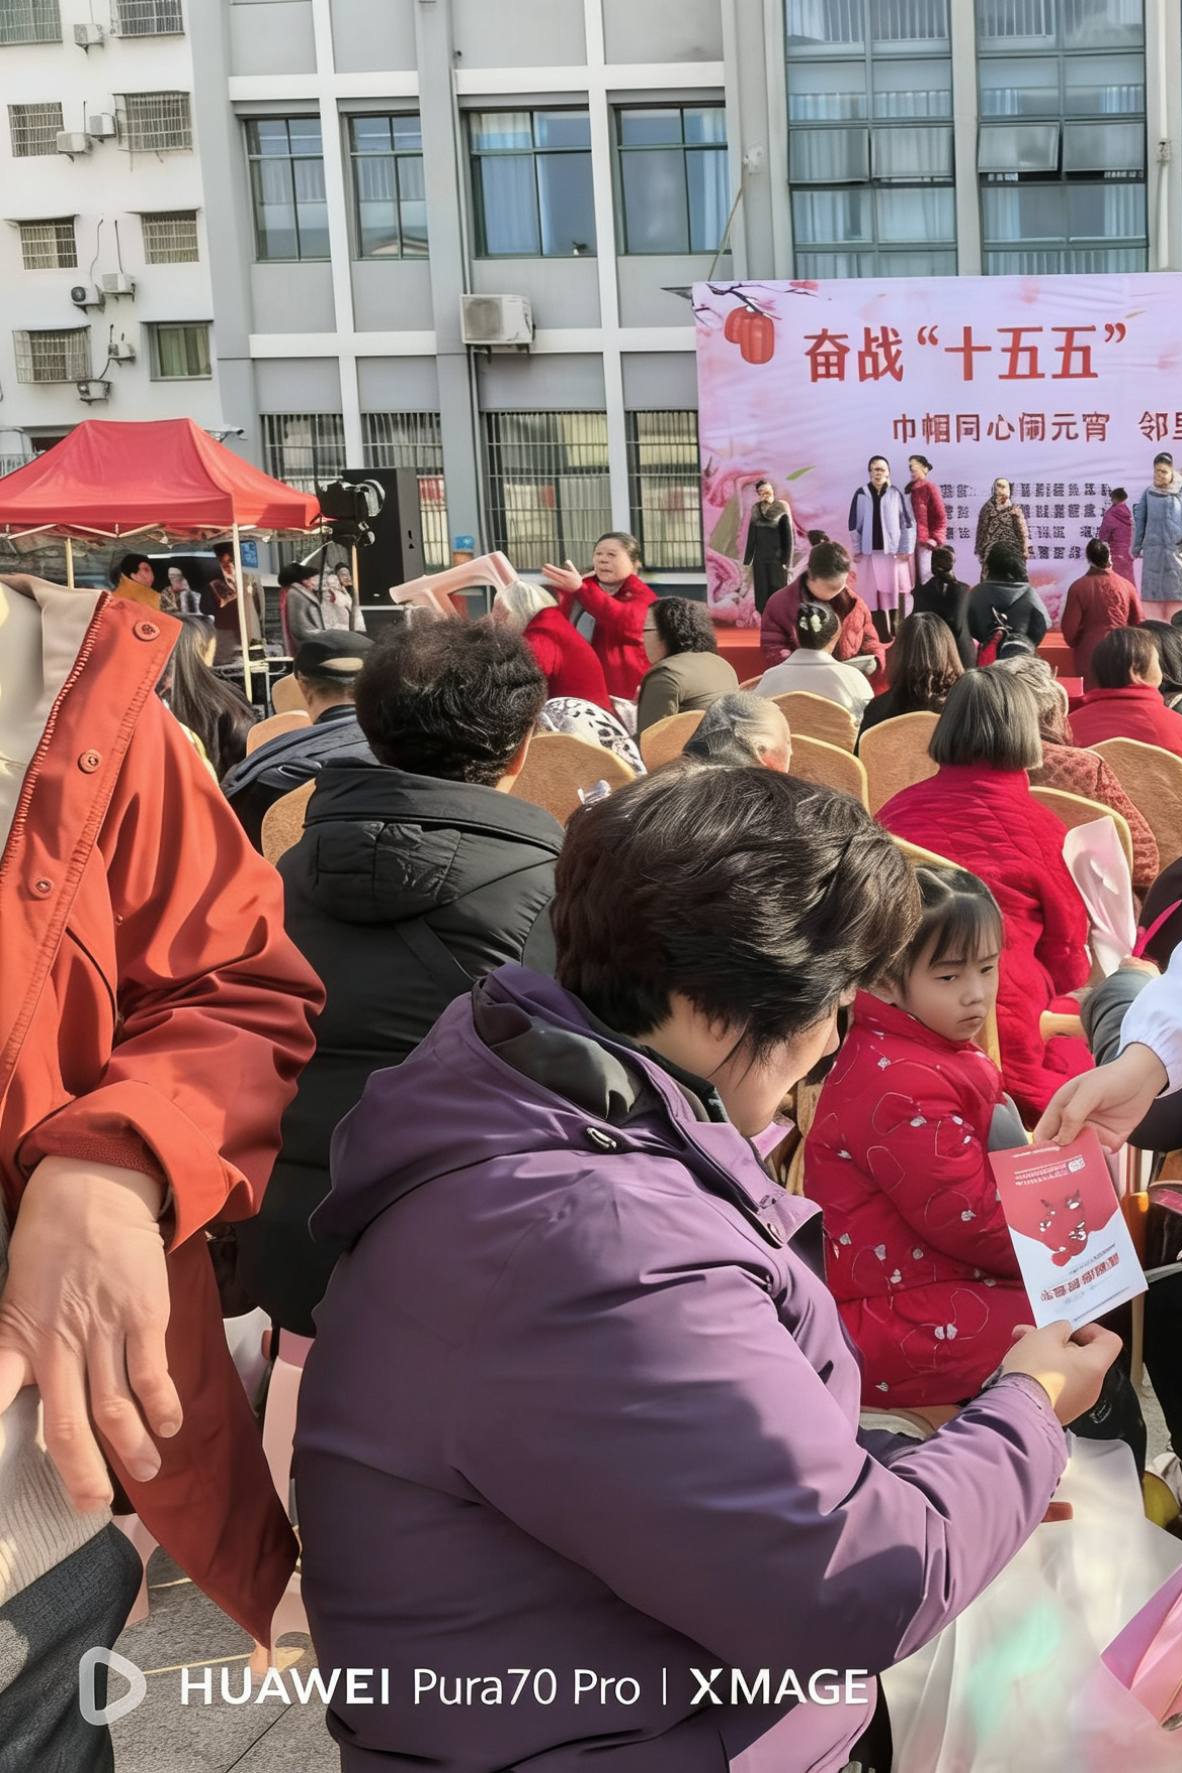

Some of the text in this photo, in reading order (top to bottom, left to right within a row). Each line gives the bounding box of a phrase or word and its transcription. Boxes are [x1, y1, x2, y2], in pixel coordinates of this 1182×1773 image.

[892, 411, 1111, 444] 巾帼同心闹元宵
